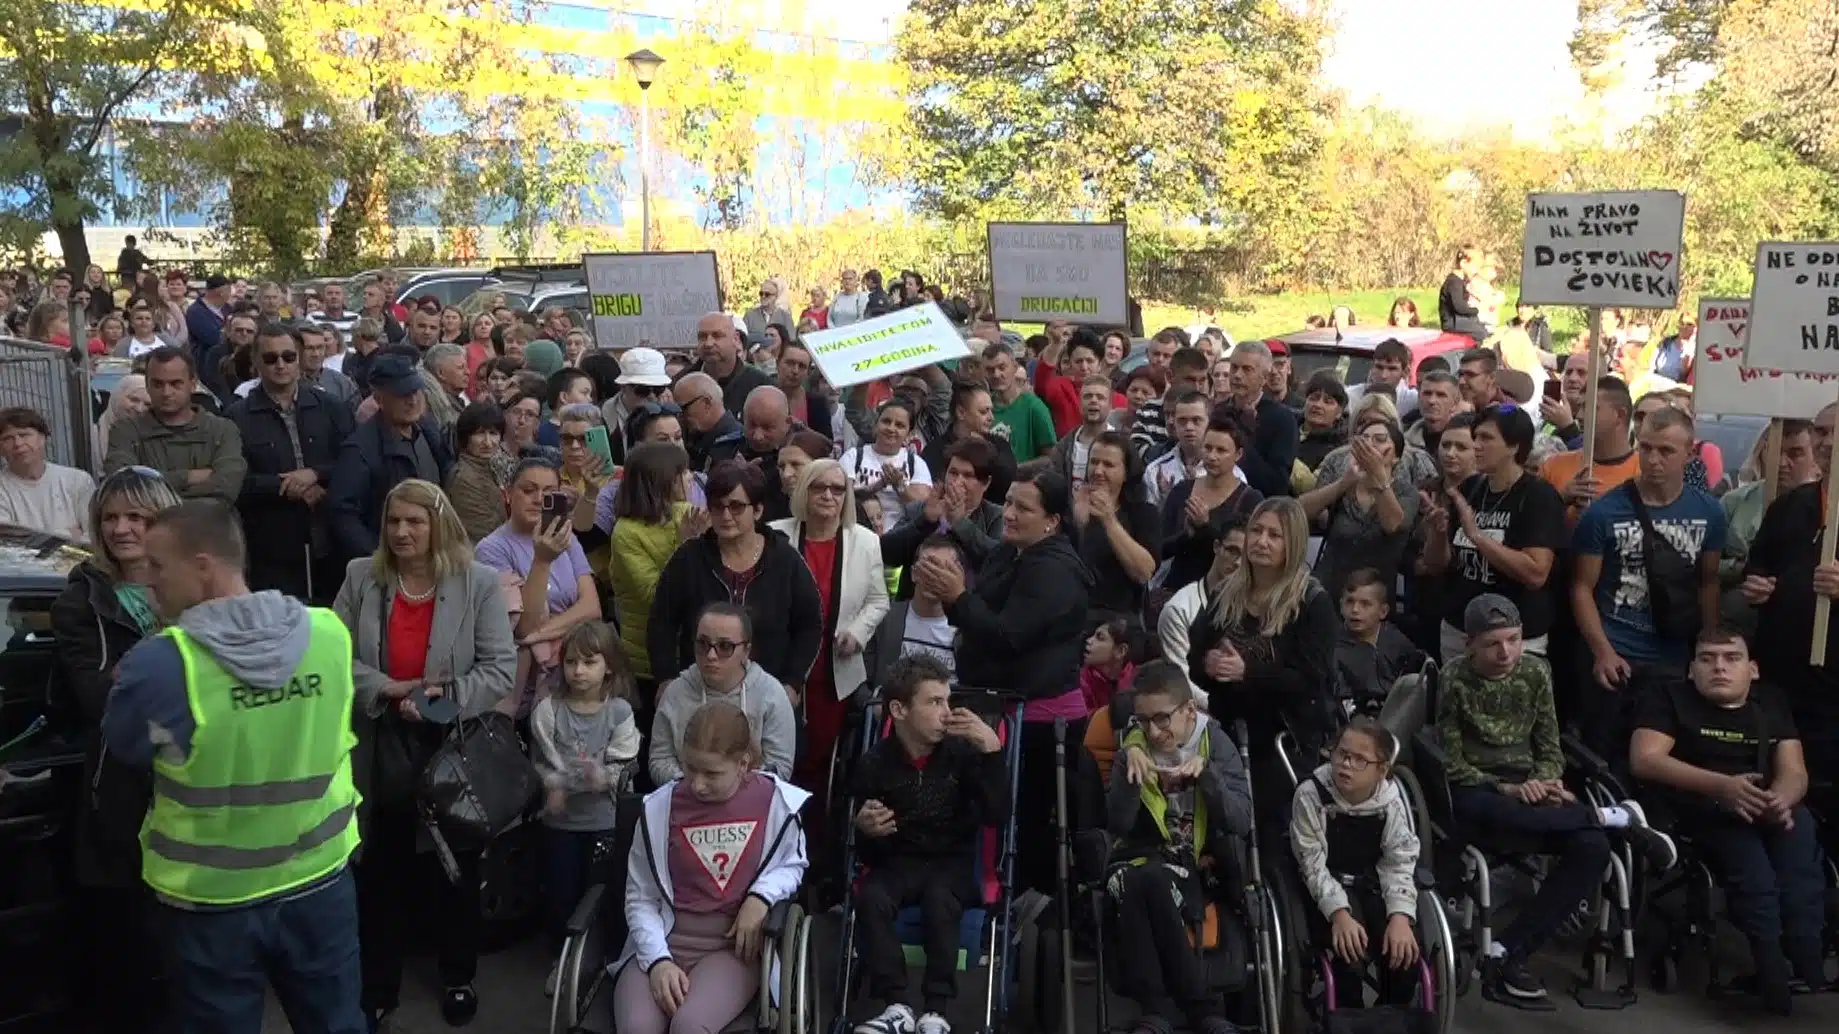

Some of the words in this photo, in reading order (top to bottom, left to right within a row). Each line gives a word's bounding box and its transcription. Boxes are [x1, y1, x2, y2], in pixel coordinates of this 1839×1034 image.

[1583, 203, 1640, 219] PRAVO
[1549, 224, 1574, 238] NA
[1577, 217, 1639, 236] ŽIVOT
[1767, 251, 1796, 269] NE
[1795, 274, 1809, 285] O
[593, 293, 642, 316] BRIGU
[851, 359, 872, 372] 27
[231, 673, 323, 710] REDAR
[690, 827, 747, 845] GUESS
